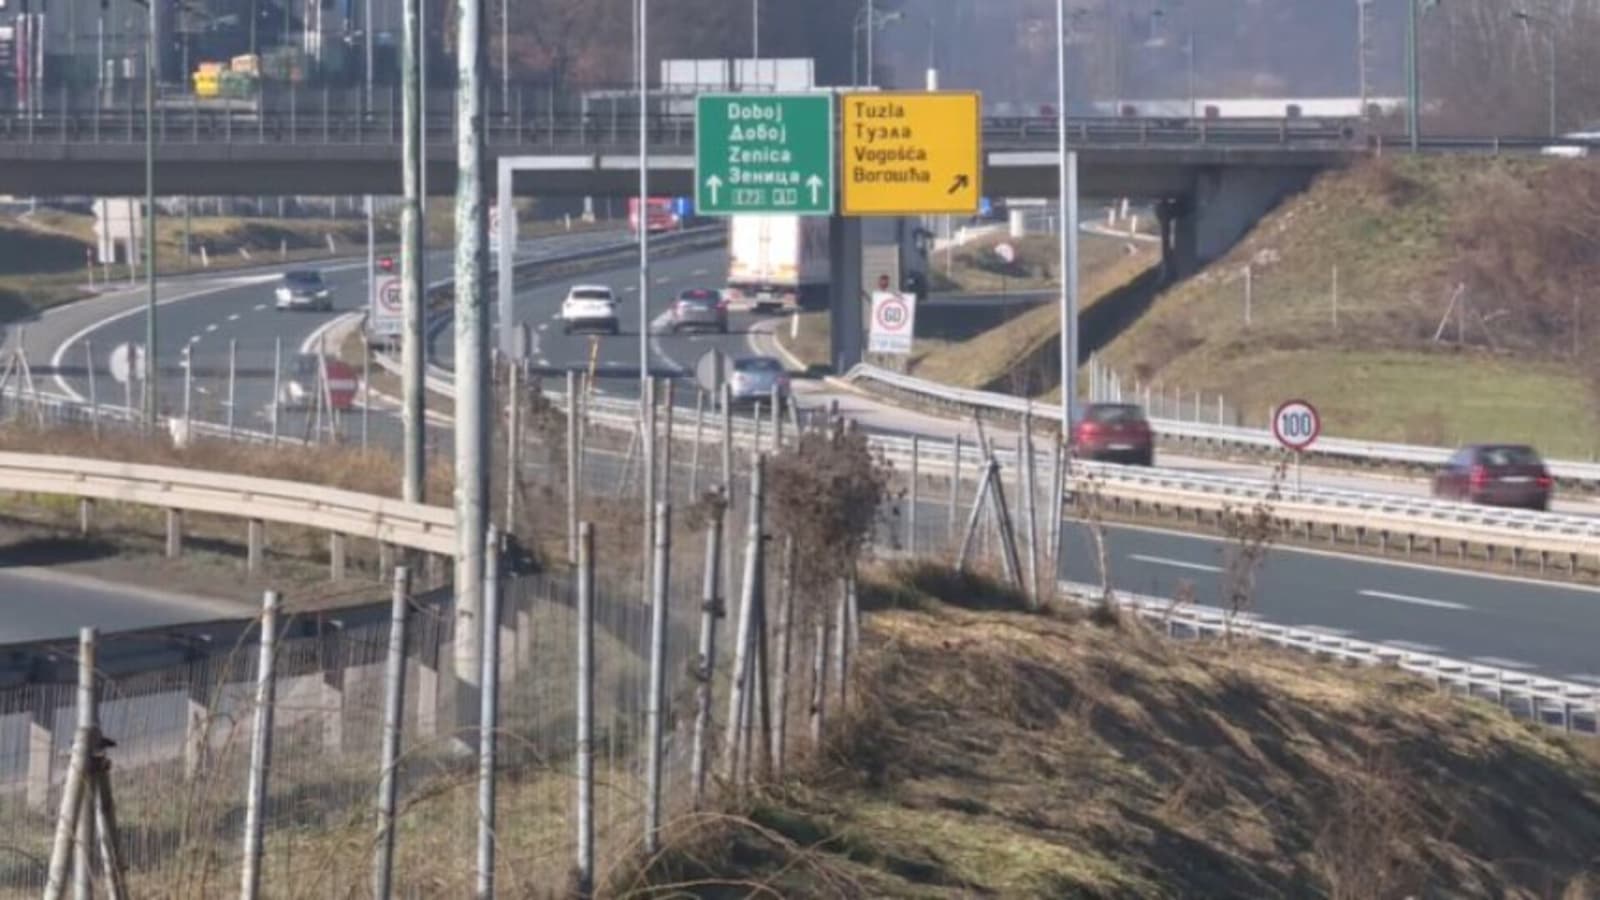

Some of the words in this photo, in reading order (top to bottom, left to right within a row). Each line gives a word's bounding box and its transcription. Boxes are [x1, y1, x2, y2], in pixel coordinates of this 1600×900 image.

[728, 102, 783, 122] Doboj
[855, 101, 905, 118] Tuzla
[728, 123, 786, 144] Добој
[855, 123, 911, 143] Тузла
[728, 146, 791, 163] Zenica
[729, 167, 800, 186] Зеница
[884, 306, 902, 322] 60
[1283, 412, 1311, 437] 100
